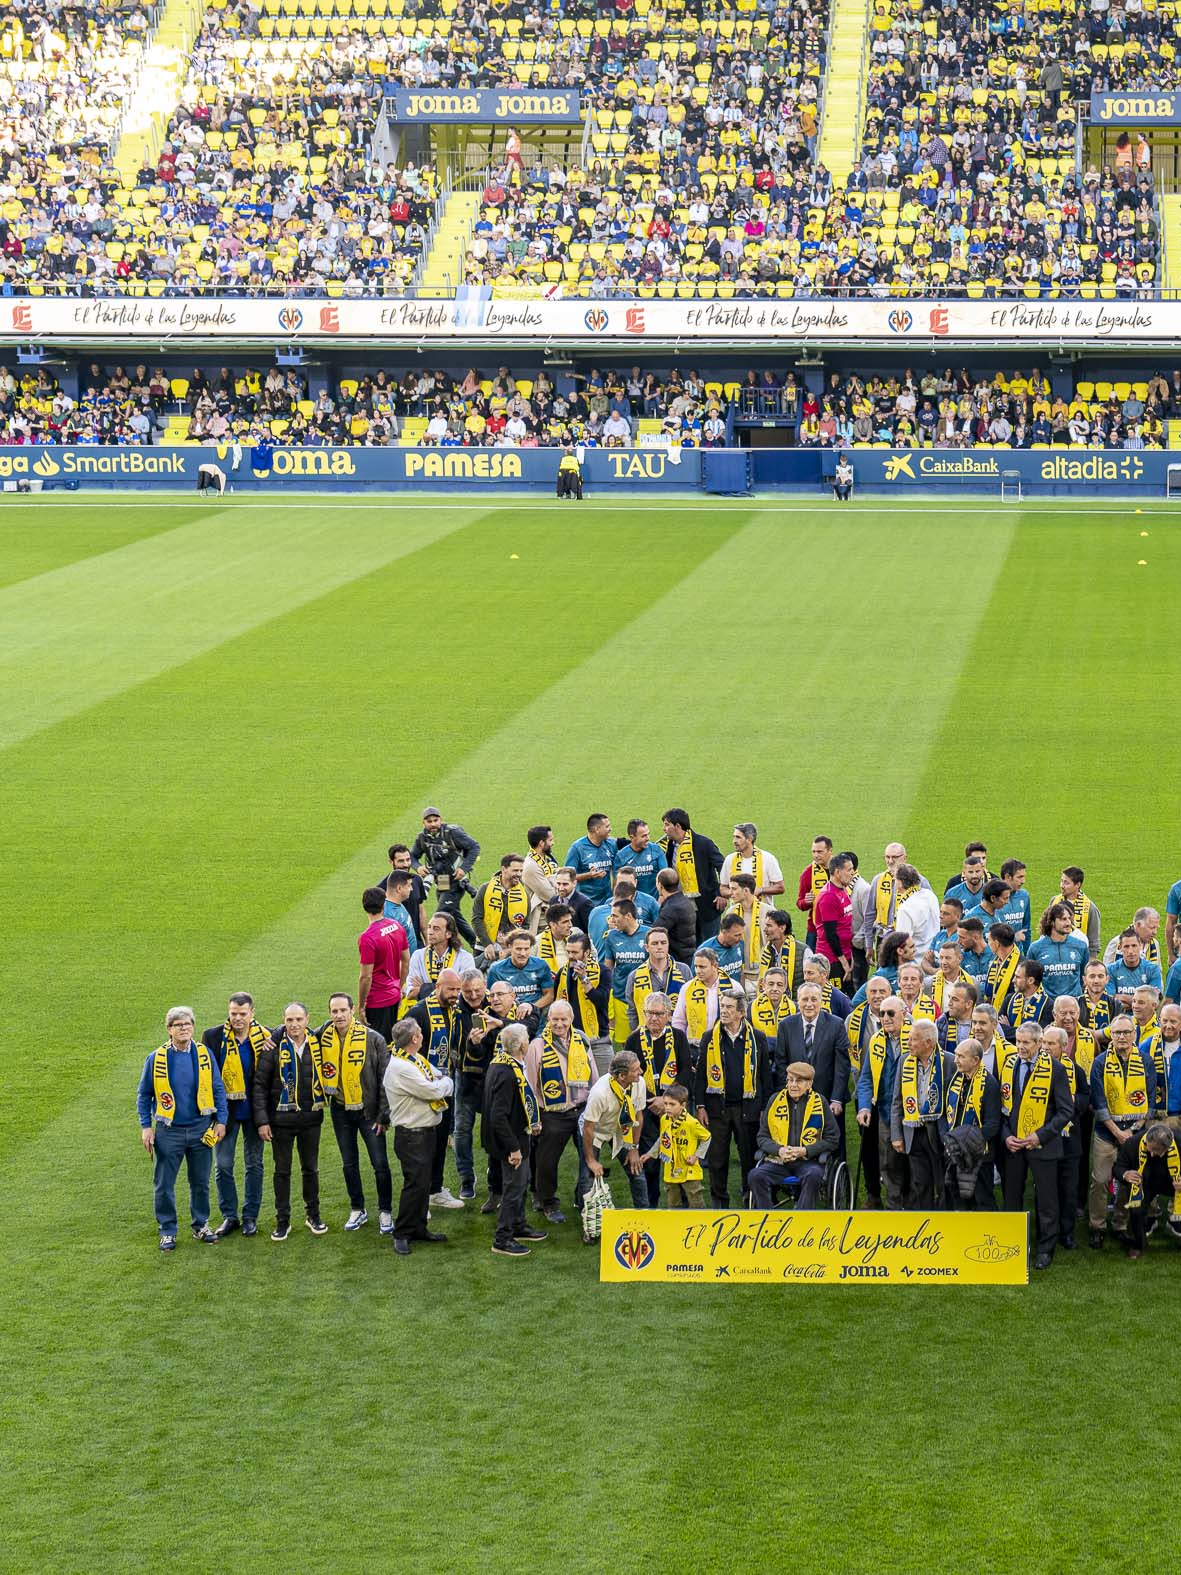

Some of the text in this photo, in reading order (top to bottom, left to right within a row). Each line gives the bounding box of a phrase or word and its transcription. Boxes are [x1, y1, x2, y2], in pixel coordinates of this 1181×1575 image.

[74, 307, 90, 325] El
[178, 304, 235, 332] Leyendas
[381, 307, 397, 325] El
[485, 304, 542, 332] Leyendas
[687, 308, 703, 326] El
[791, 305, 848, 333] Leyendas
[991, 309, 1007, 327] El
[1095, 306, 1152, 334] Leyendas
[63, 452, 186, 473] SmartBank
[252, 450, 356, 478] oma
[405, 453, 522, 477] PAMESA
[608, 453, 667, 478] TAU
[920, 456, 1000, 473] CaixaBank
[1041, 456, 1117, 480] altadia
[615, 951, 646, 960] PAMESA
[1044, 963, 1077, 972] PAMESA
[1030, 1085, 1049, 1105] CF
[682, 1213, 944, 1264] El Partido de las Leyendas
[666, 1264, 704, 1272] PAMESA
[733, 1266, 773, 1275] CaixaBank
[917, 1267, 959, 1276] ZOOMEX
